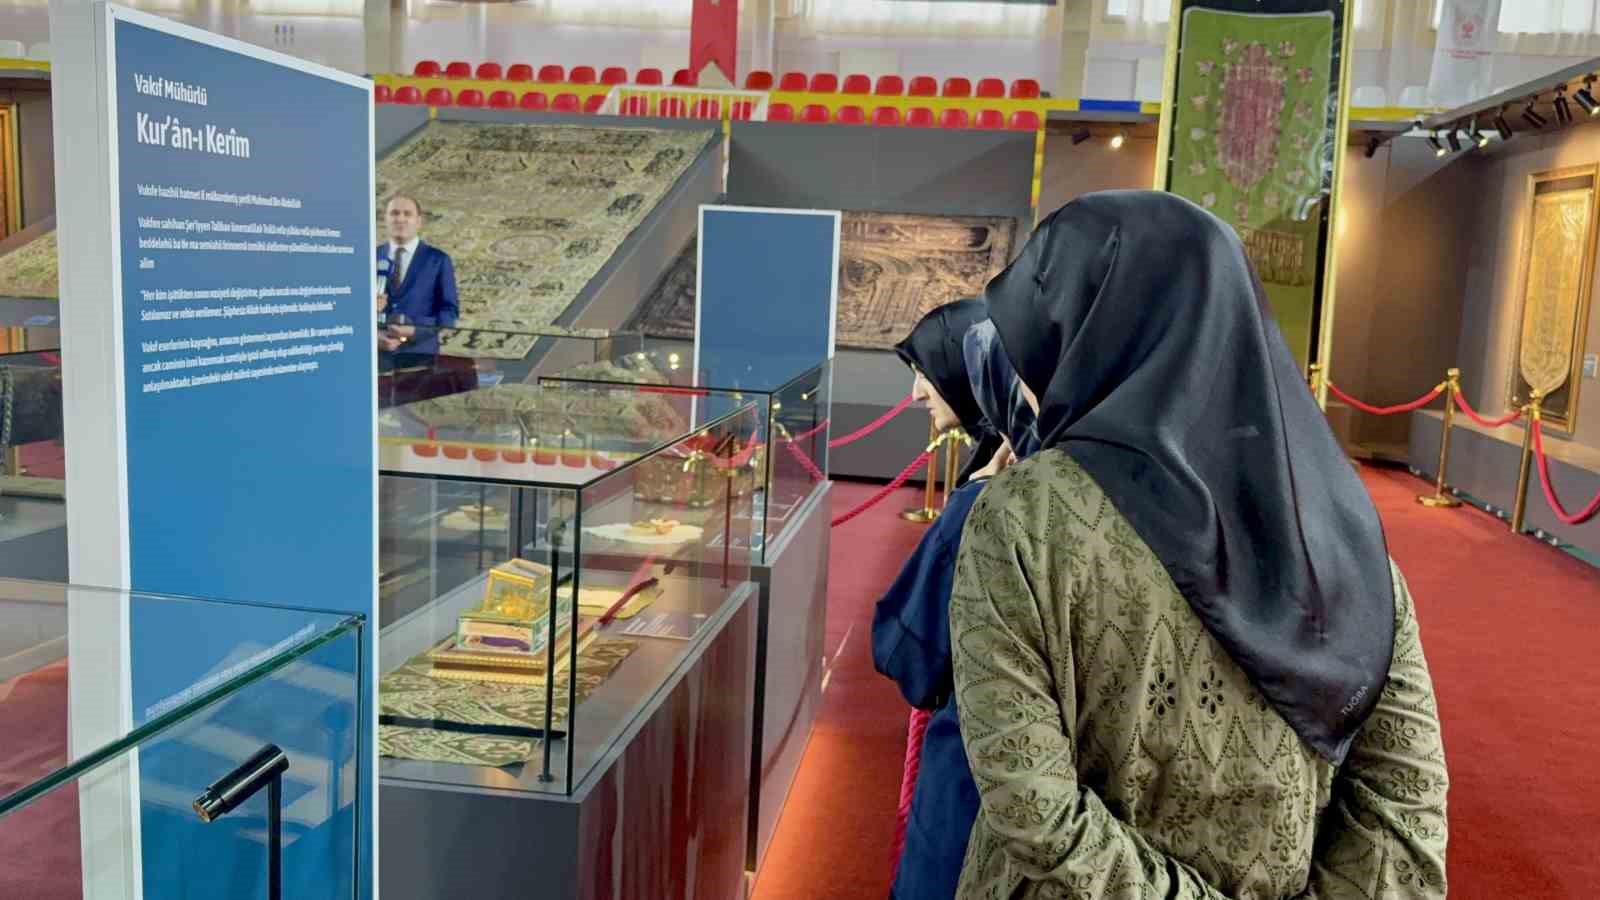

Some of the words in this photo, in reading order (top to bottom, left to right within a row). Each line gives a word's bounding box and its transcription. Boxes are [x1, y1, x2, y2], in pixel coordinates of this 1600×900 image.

[134, 72, 164, 97] Vakıf
[164, 79, 208, 107] Mühürlü
[205, 123, 250, 159] Kerîm
